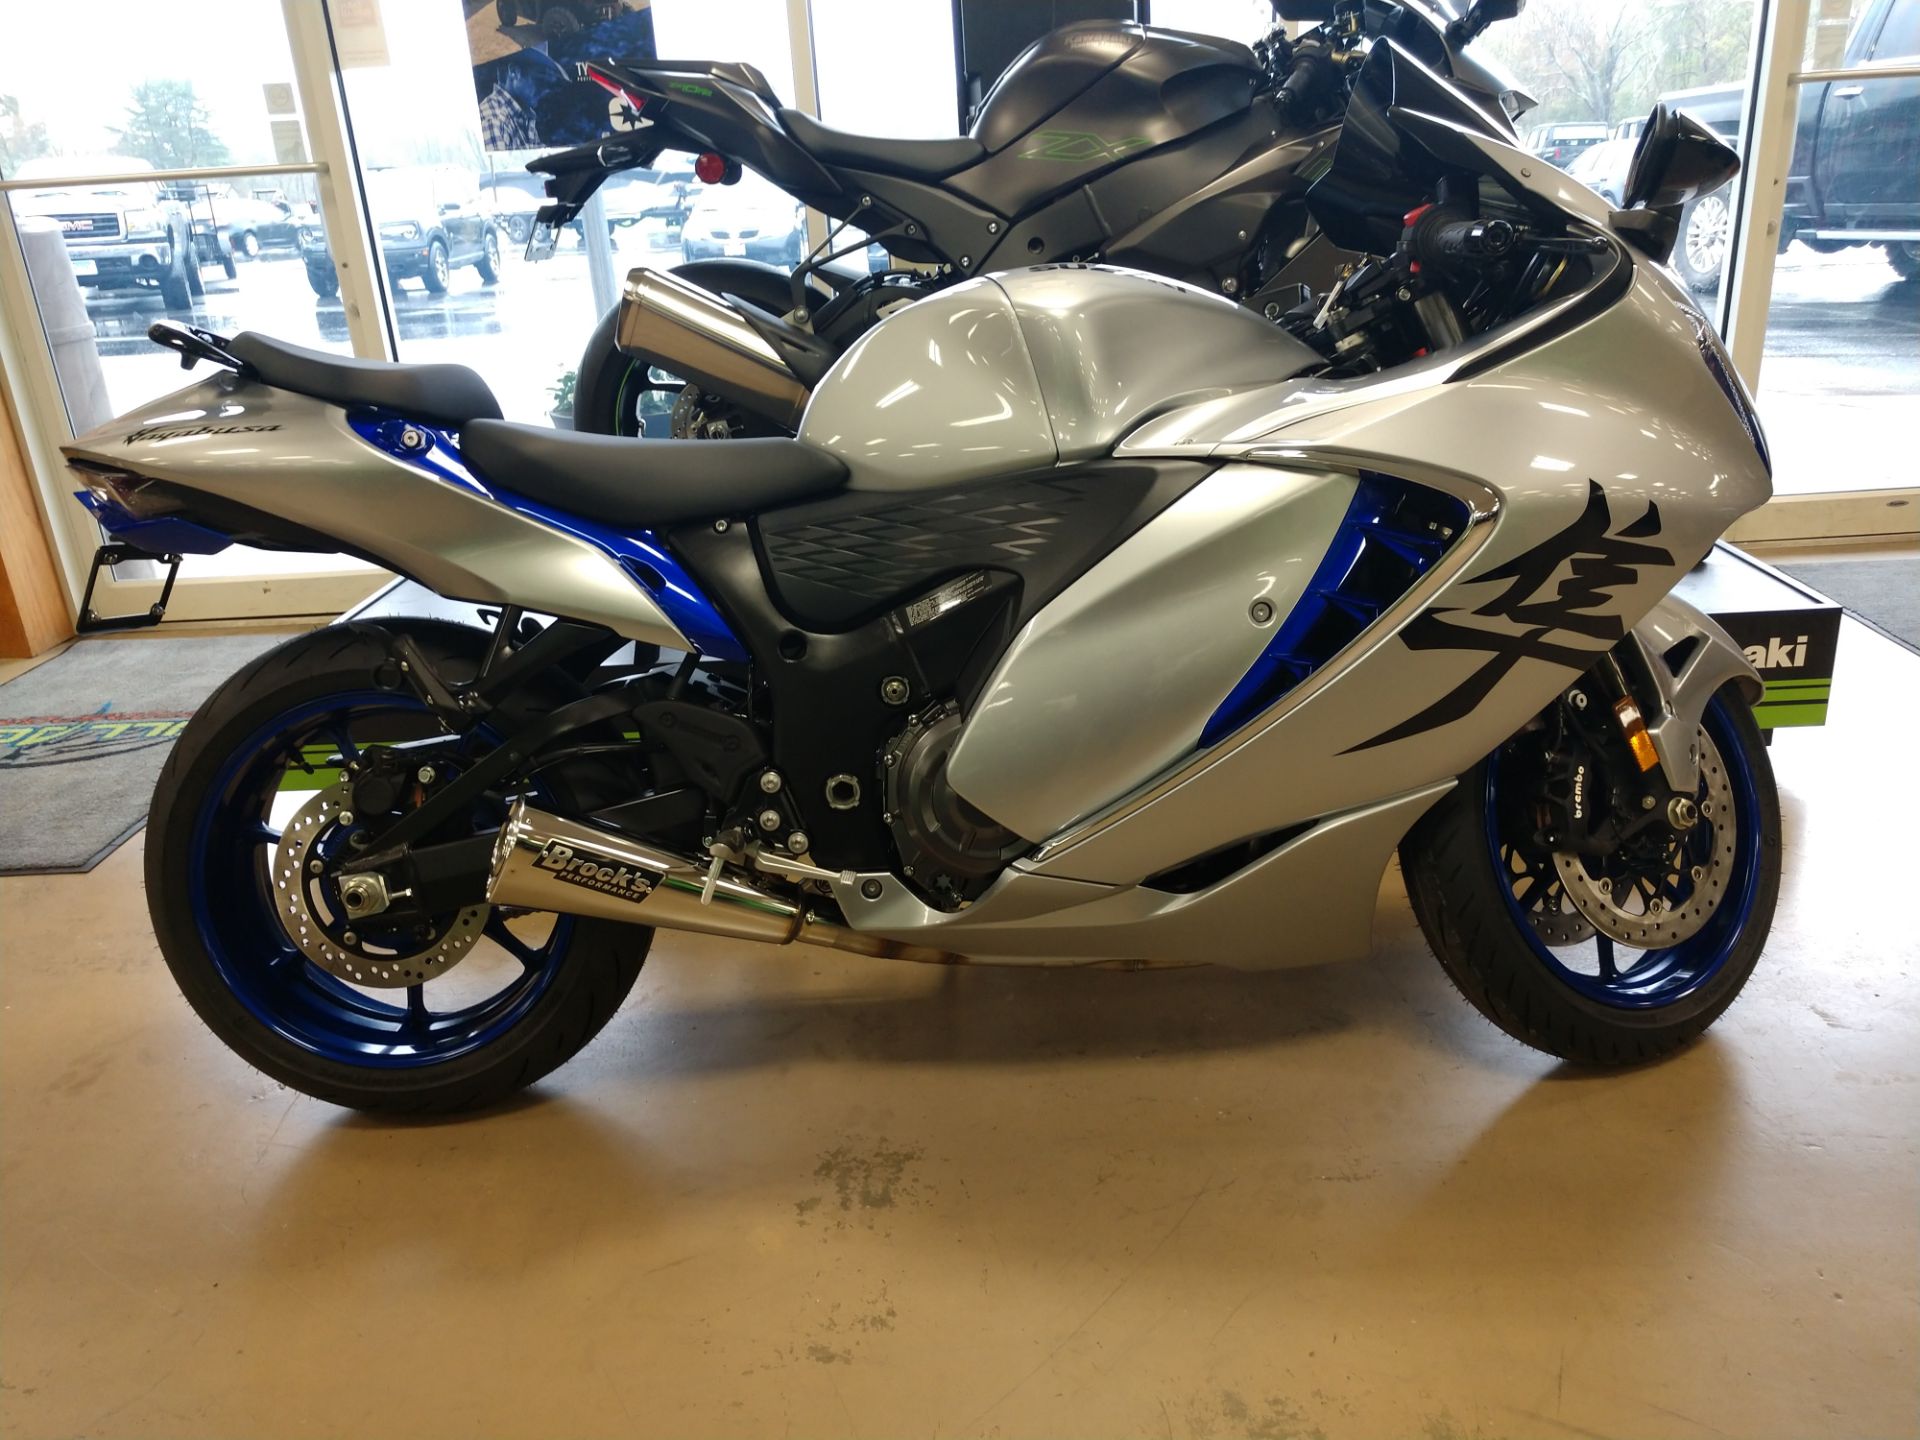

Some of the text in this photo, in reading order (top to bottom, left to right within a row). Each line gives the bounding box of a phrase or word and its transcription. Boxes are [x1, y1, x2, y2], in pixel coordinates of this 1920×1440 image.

[1573, 765, 1585, 819] brembo
[541, 844, 651, 893] Brock's
[559, 871, 641, 899] PERFORMANCE
